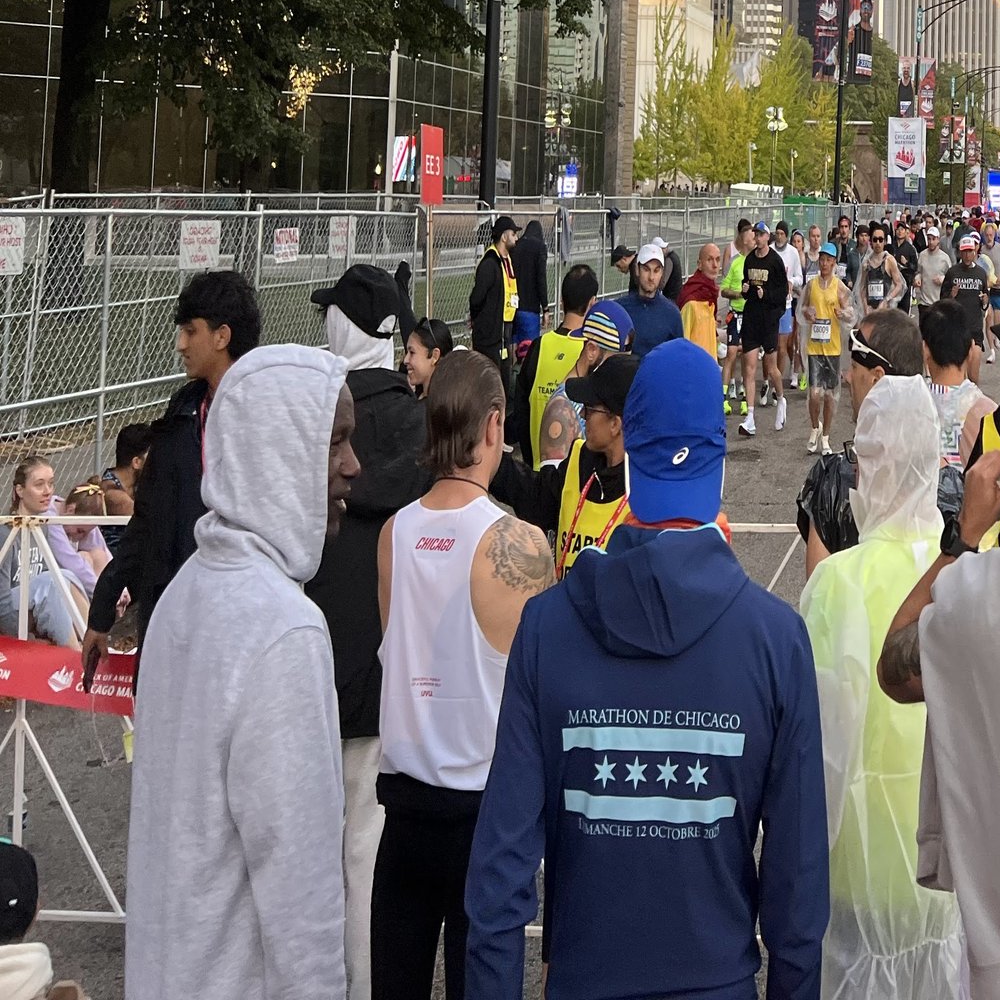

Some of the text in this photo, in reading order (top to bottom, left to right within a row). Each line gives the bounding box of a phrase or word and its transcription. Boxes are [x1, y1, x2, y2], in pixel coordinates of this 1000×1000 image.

[436, 156, 440, 176] 3
[415, 537, 455, 552] CHICAGO
[568, 709, 740, 729] MARATHON DE CHICAGO
[636, 825, 647, 837] 12
[649, 825, 700, 840] OCTOBRE
